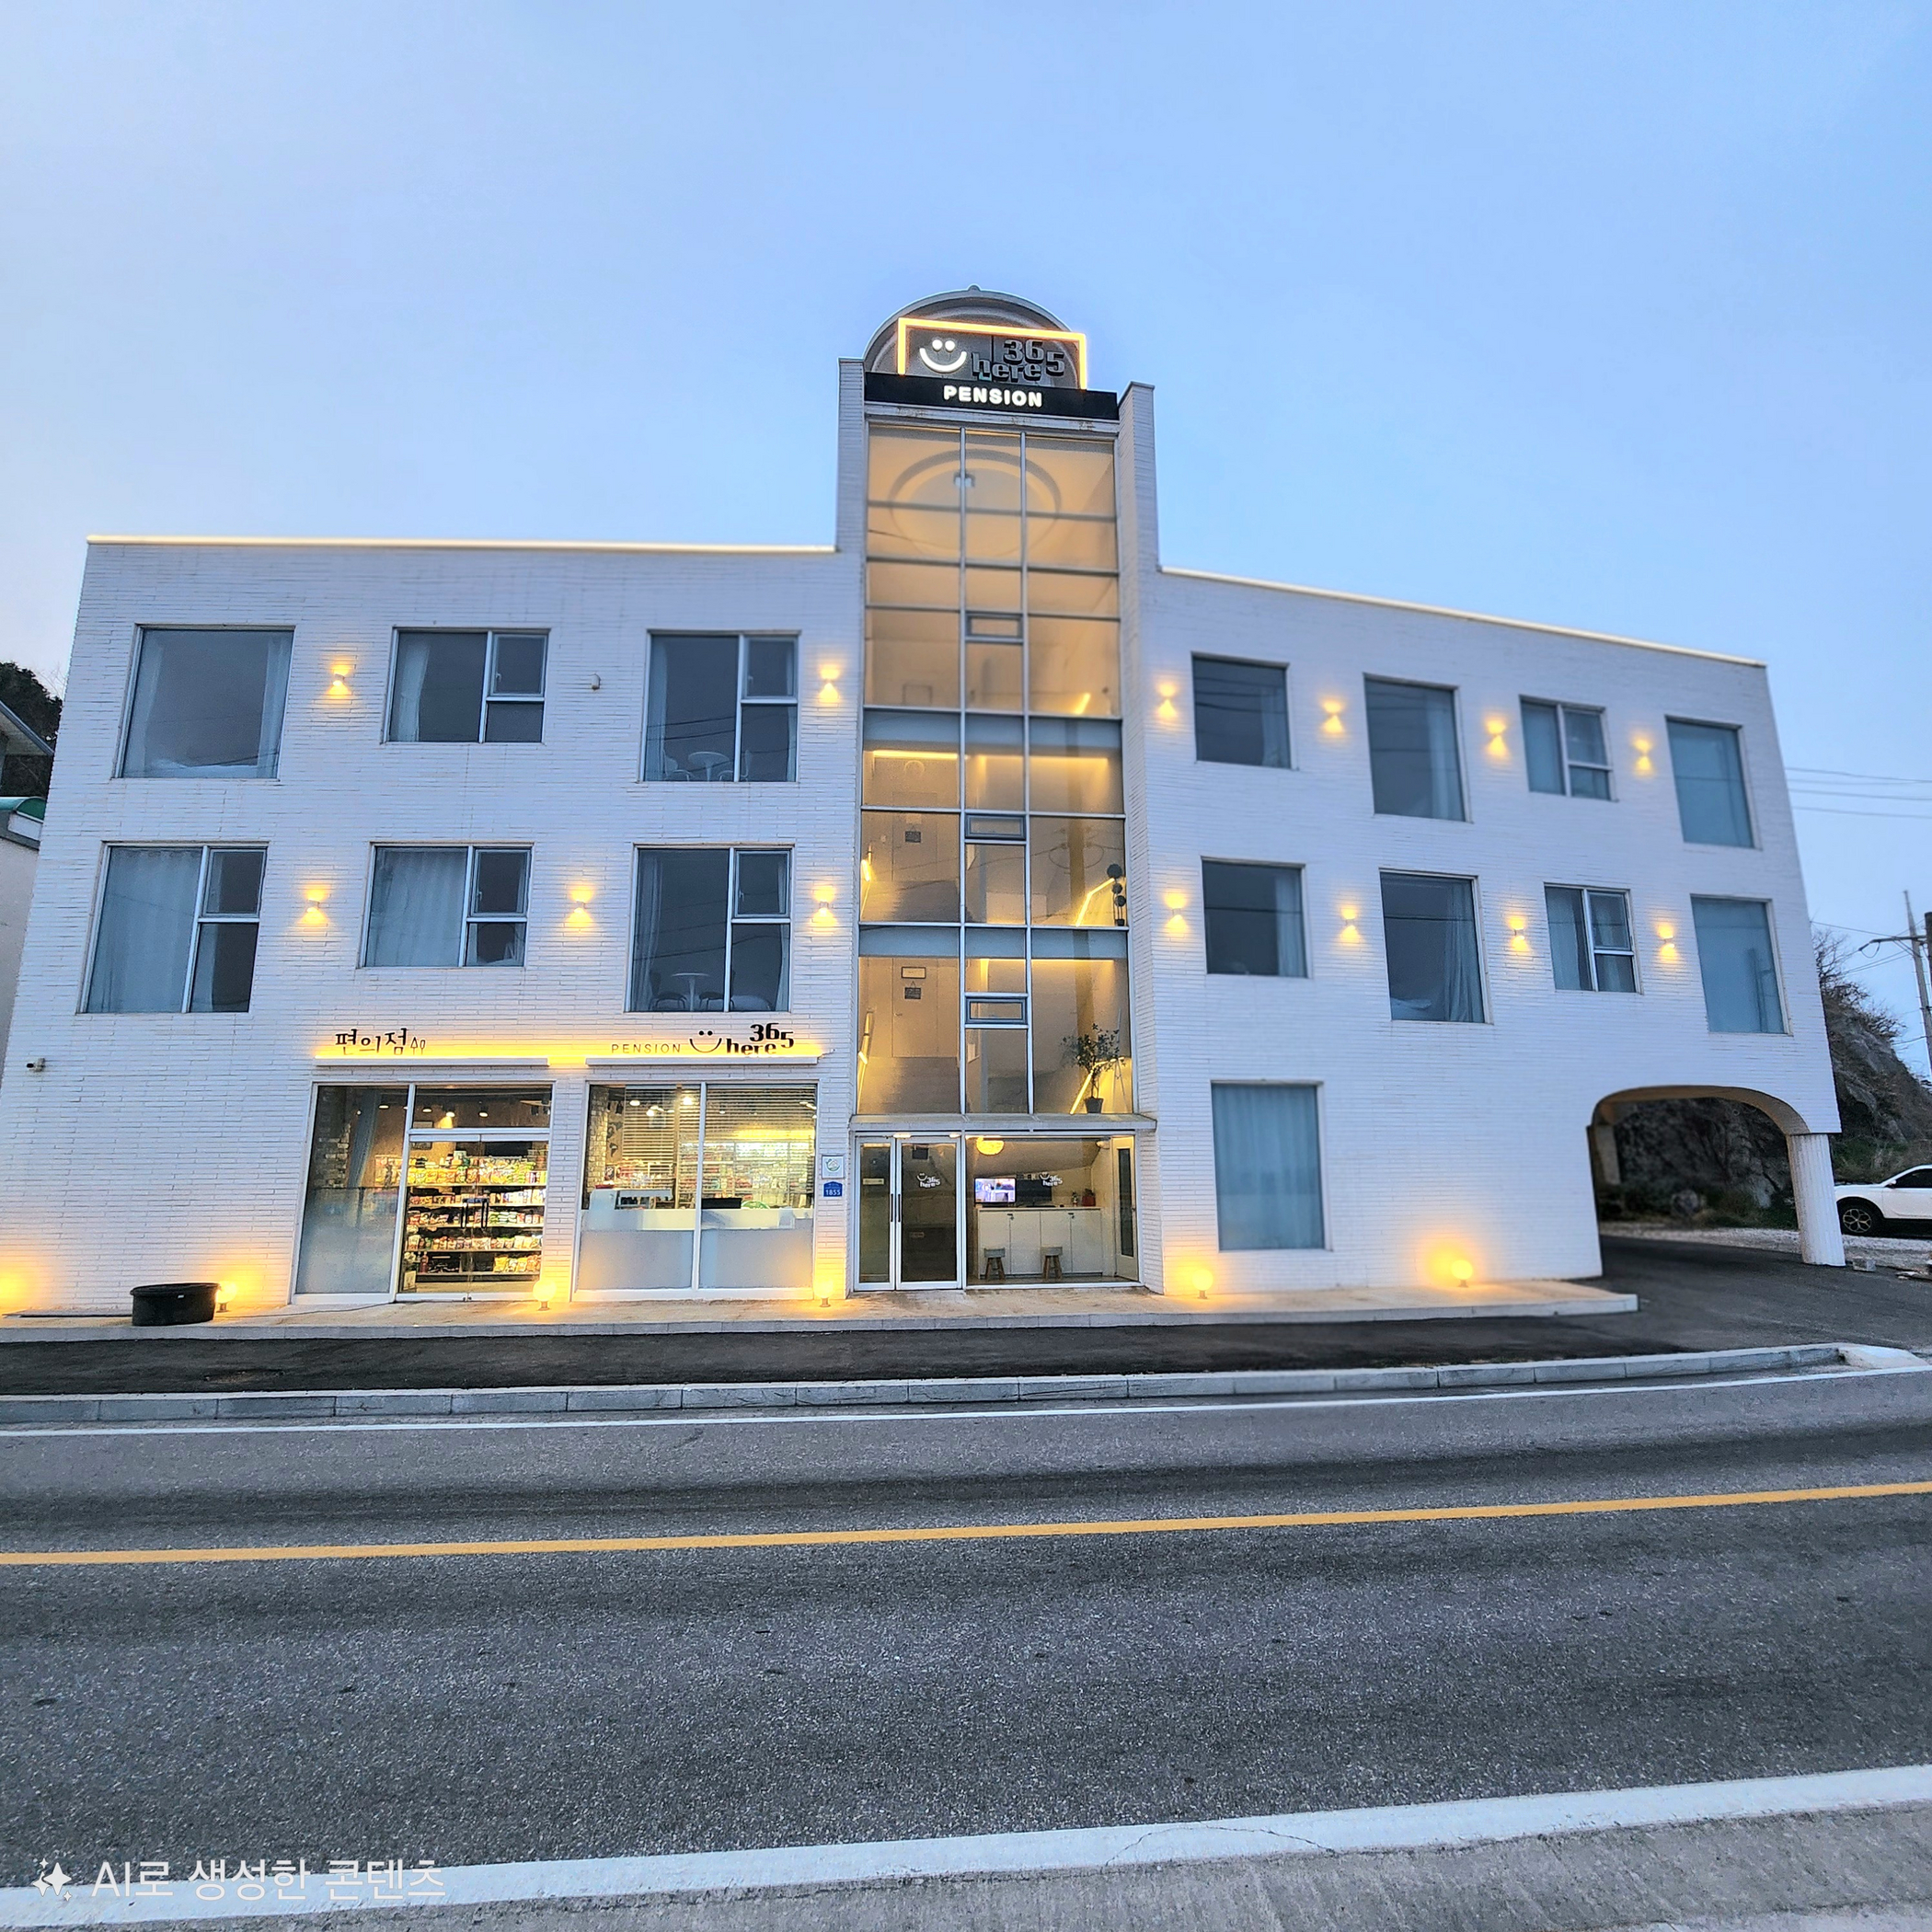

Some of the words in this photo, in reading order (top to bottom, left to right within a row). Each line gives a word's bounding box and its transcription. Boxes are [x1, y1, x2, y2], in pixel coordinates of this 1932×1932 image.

[972, 352, 1041, 383] here
[1004, 339, 1065, 376] 365
[943, 385, 1042, 408] PENSION
[335, 1028, 408, 1055] 편의점
[611, 1043, 681, 1054] PENSION
[726, 1038, 776, 1055] here
[749, 1022, 795, 1049] 365
